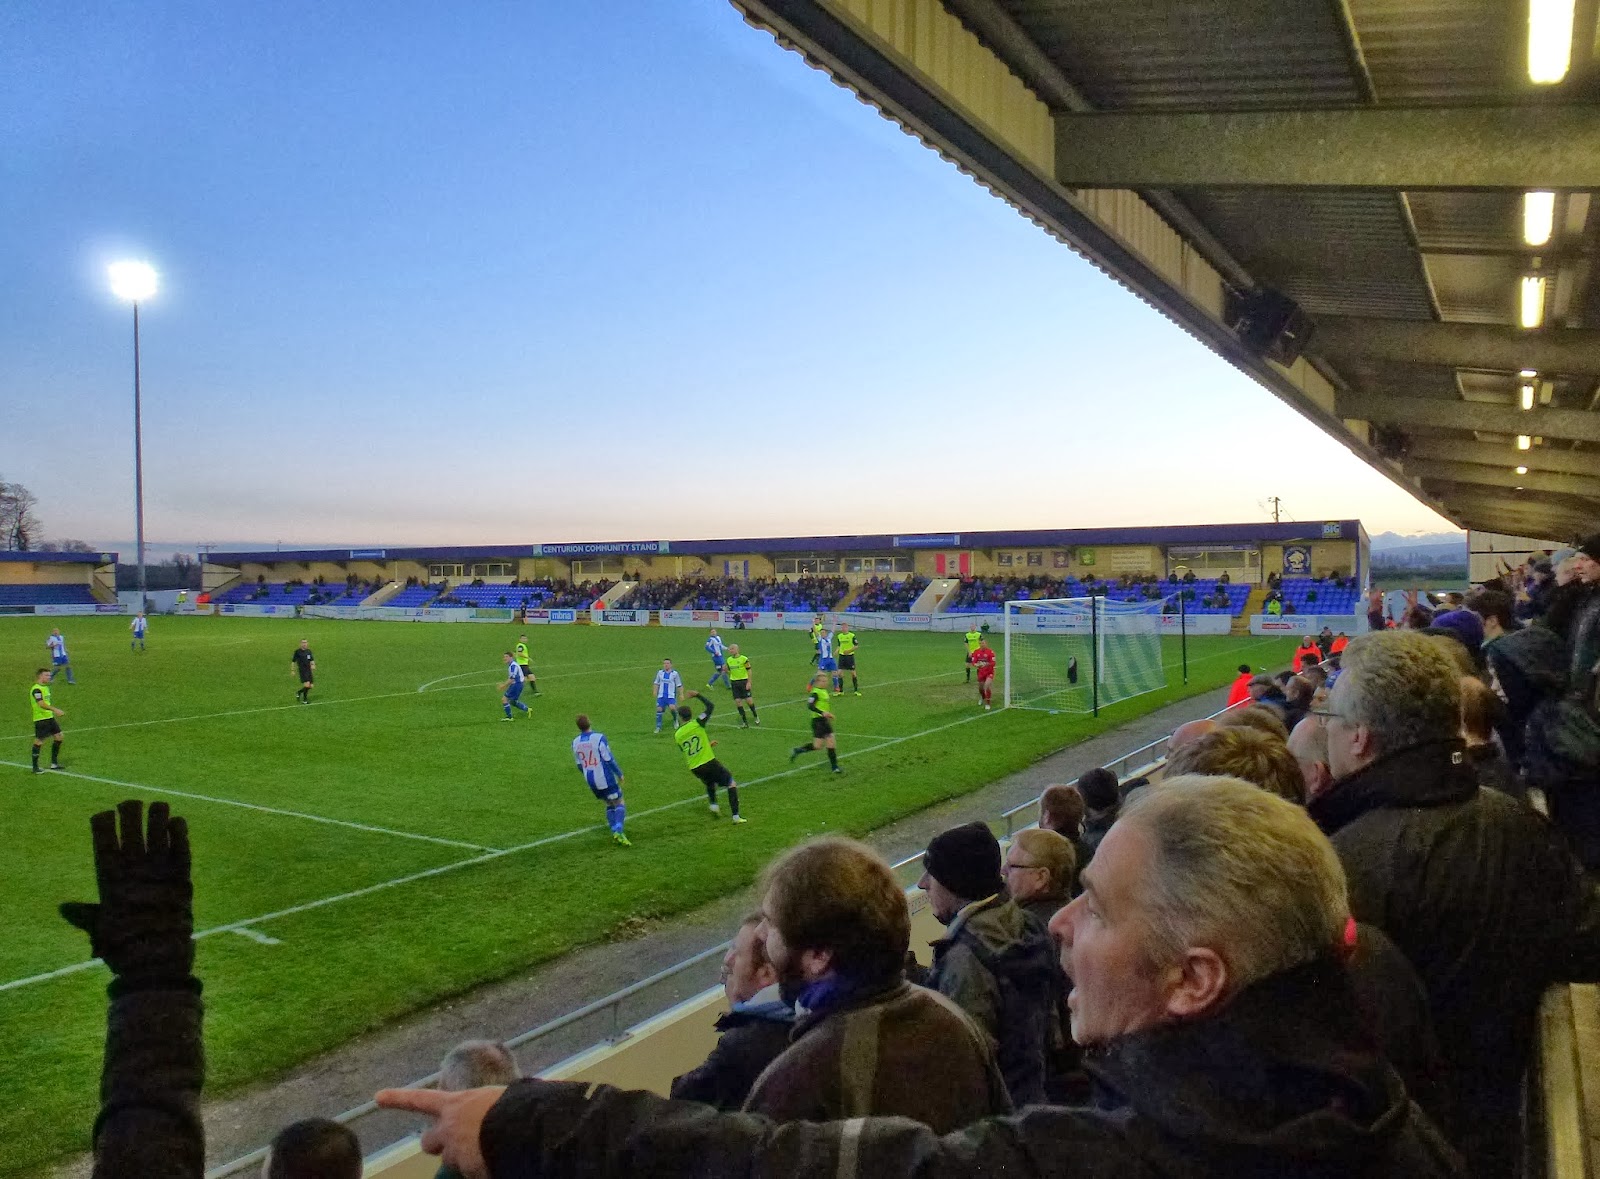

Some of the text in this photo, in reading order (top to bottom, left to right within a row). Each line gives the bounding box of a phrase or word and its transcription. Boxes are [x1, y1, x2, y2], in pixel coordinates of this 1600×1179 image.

[1323, 525, 1340, 533] BIG
[543, 542, 658, 554] CENTURION COMMUNITY STAND
[552, 610, 572, 619] mbna
[683, 736, 703, 757] 22
[576, 750, 598, 768] 34
